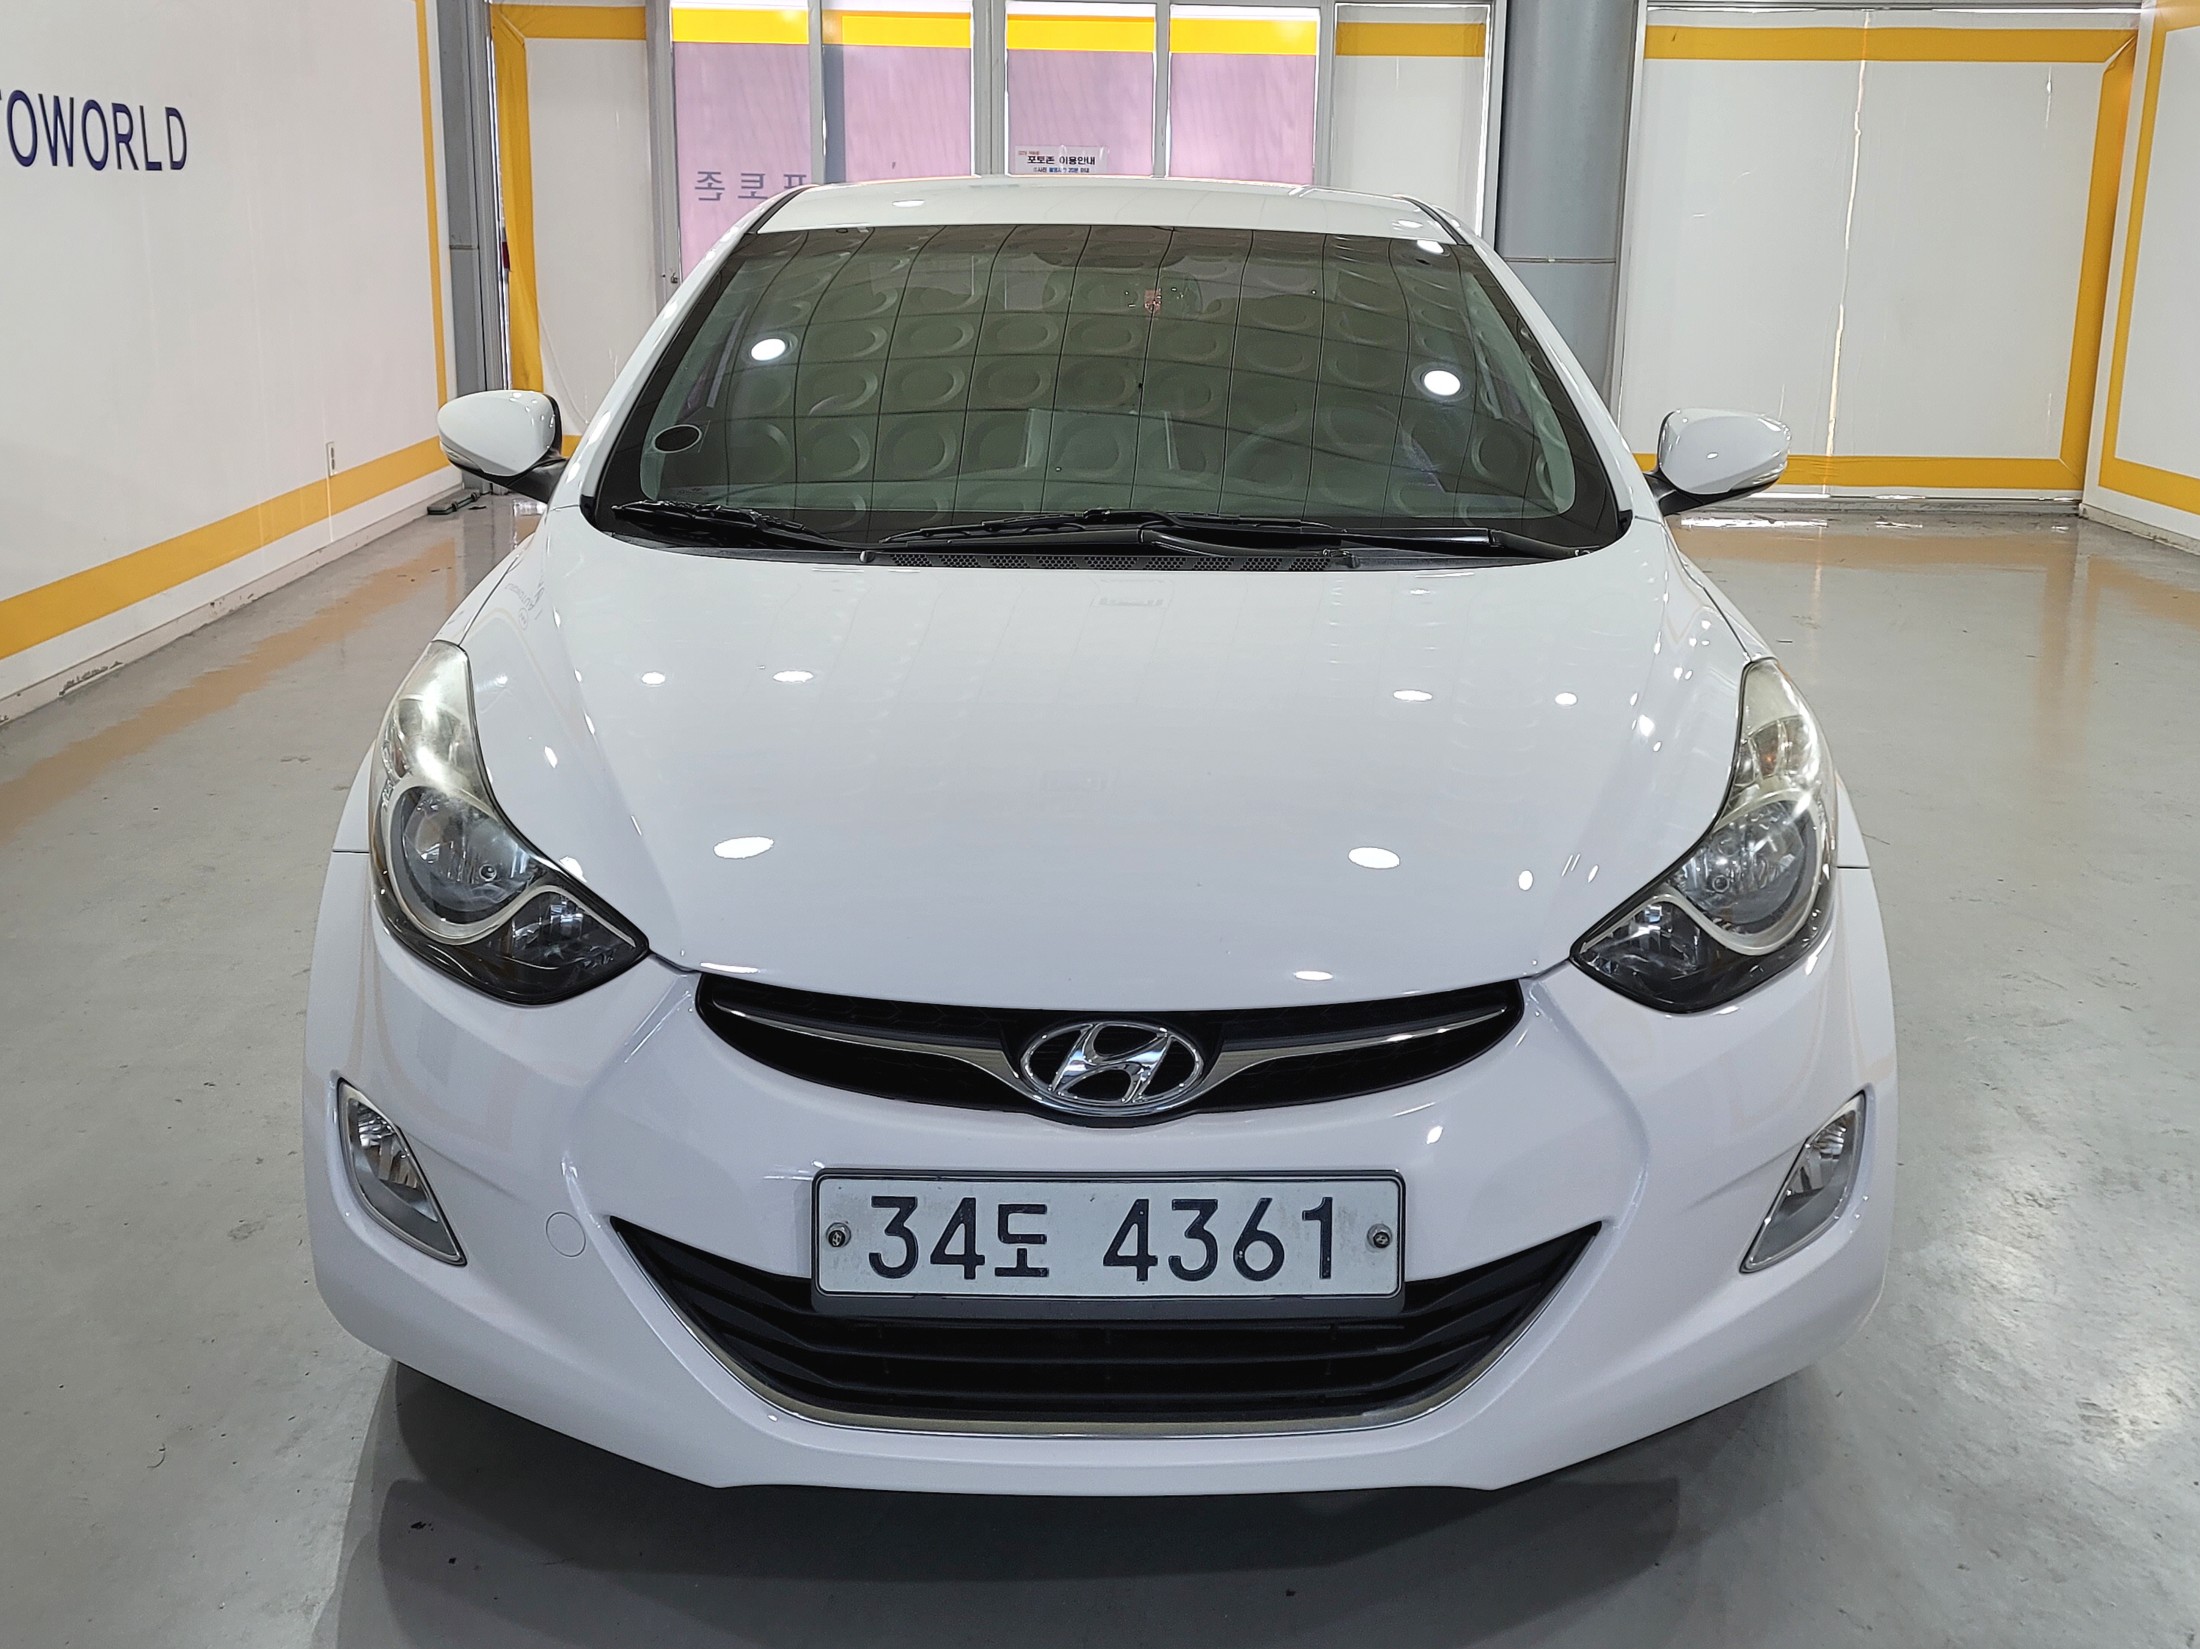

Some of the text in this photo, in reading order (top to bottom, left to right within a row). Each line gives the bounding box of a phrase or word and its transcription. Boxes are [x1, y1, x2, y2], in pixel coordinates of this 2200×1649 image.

[0, 89, 188, 171] OWORLD
[1027, 155, 1096, 165] 포토존 이용안내
[868, 1194, 1334, 1282] 34도 4361
